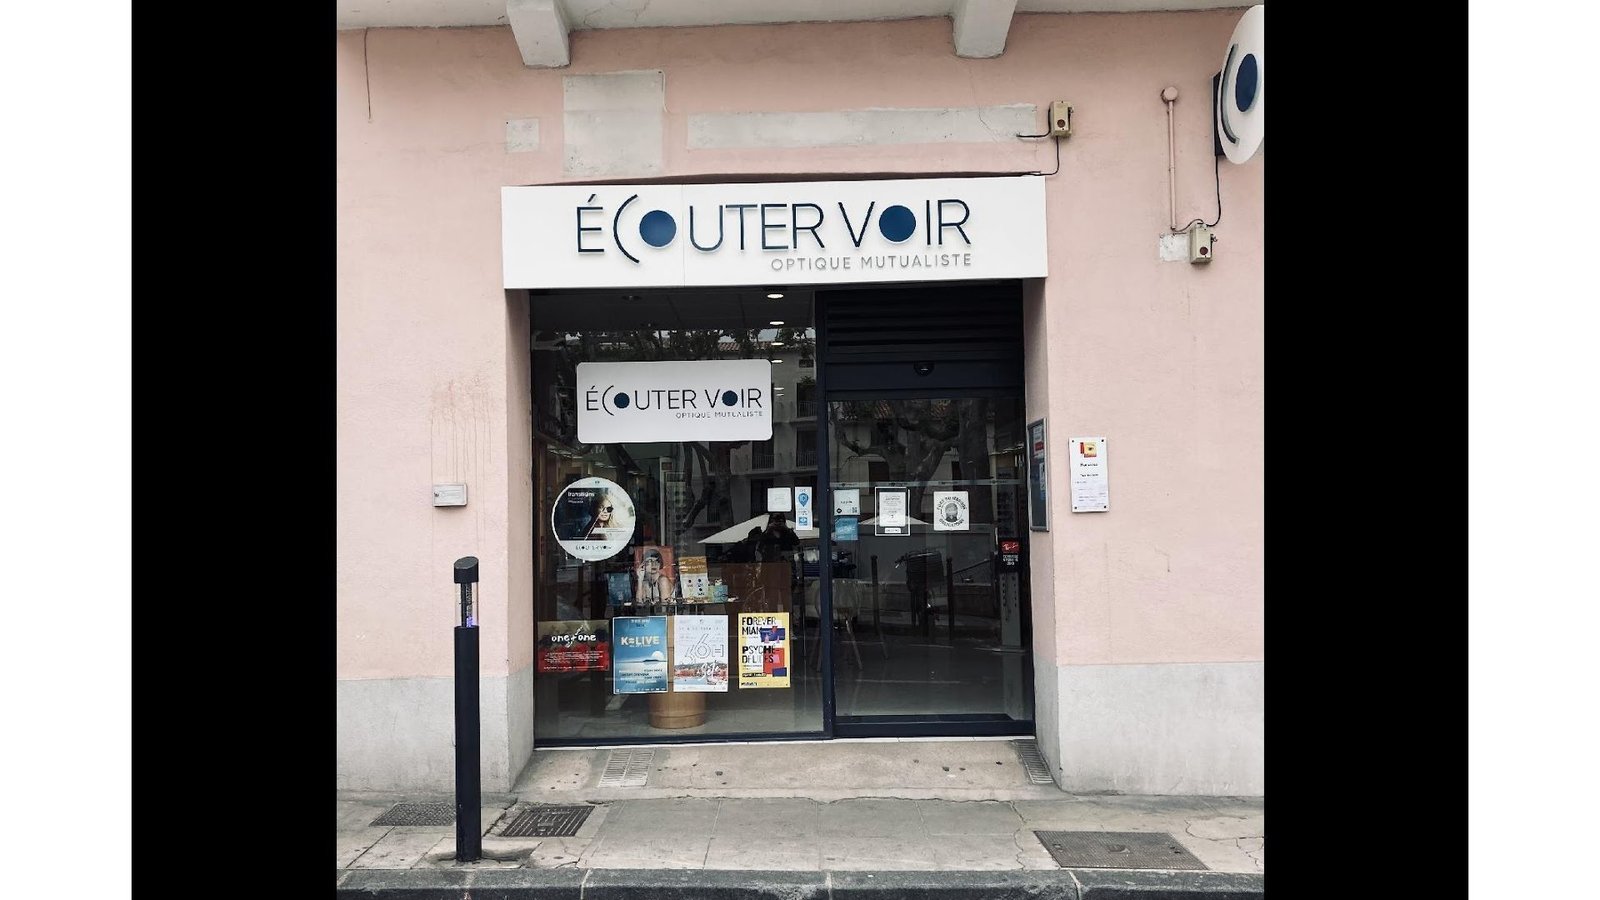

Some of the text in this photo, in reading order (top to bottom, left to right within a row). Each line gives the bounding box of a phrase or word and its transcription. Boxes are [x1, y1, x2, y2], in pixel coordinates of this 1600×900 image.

[576, 193, 972, 264] ÉCOUTER VOIR
[770, 253, 972, 271] OPTIQUE MUTUALISTE
[586, 385, 763, 416] ÉCOUTER VOIR
[675, 410, 763, 419] OPTIQUE MUTUALISTE
[741, 616, 776, 625] FOREVER
